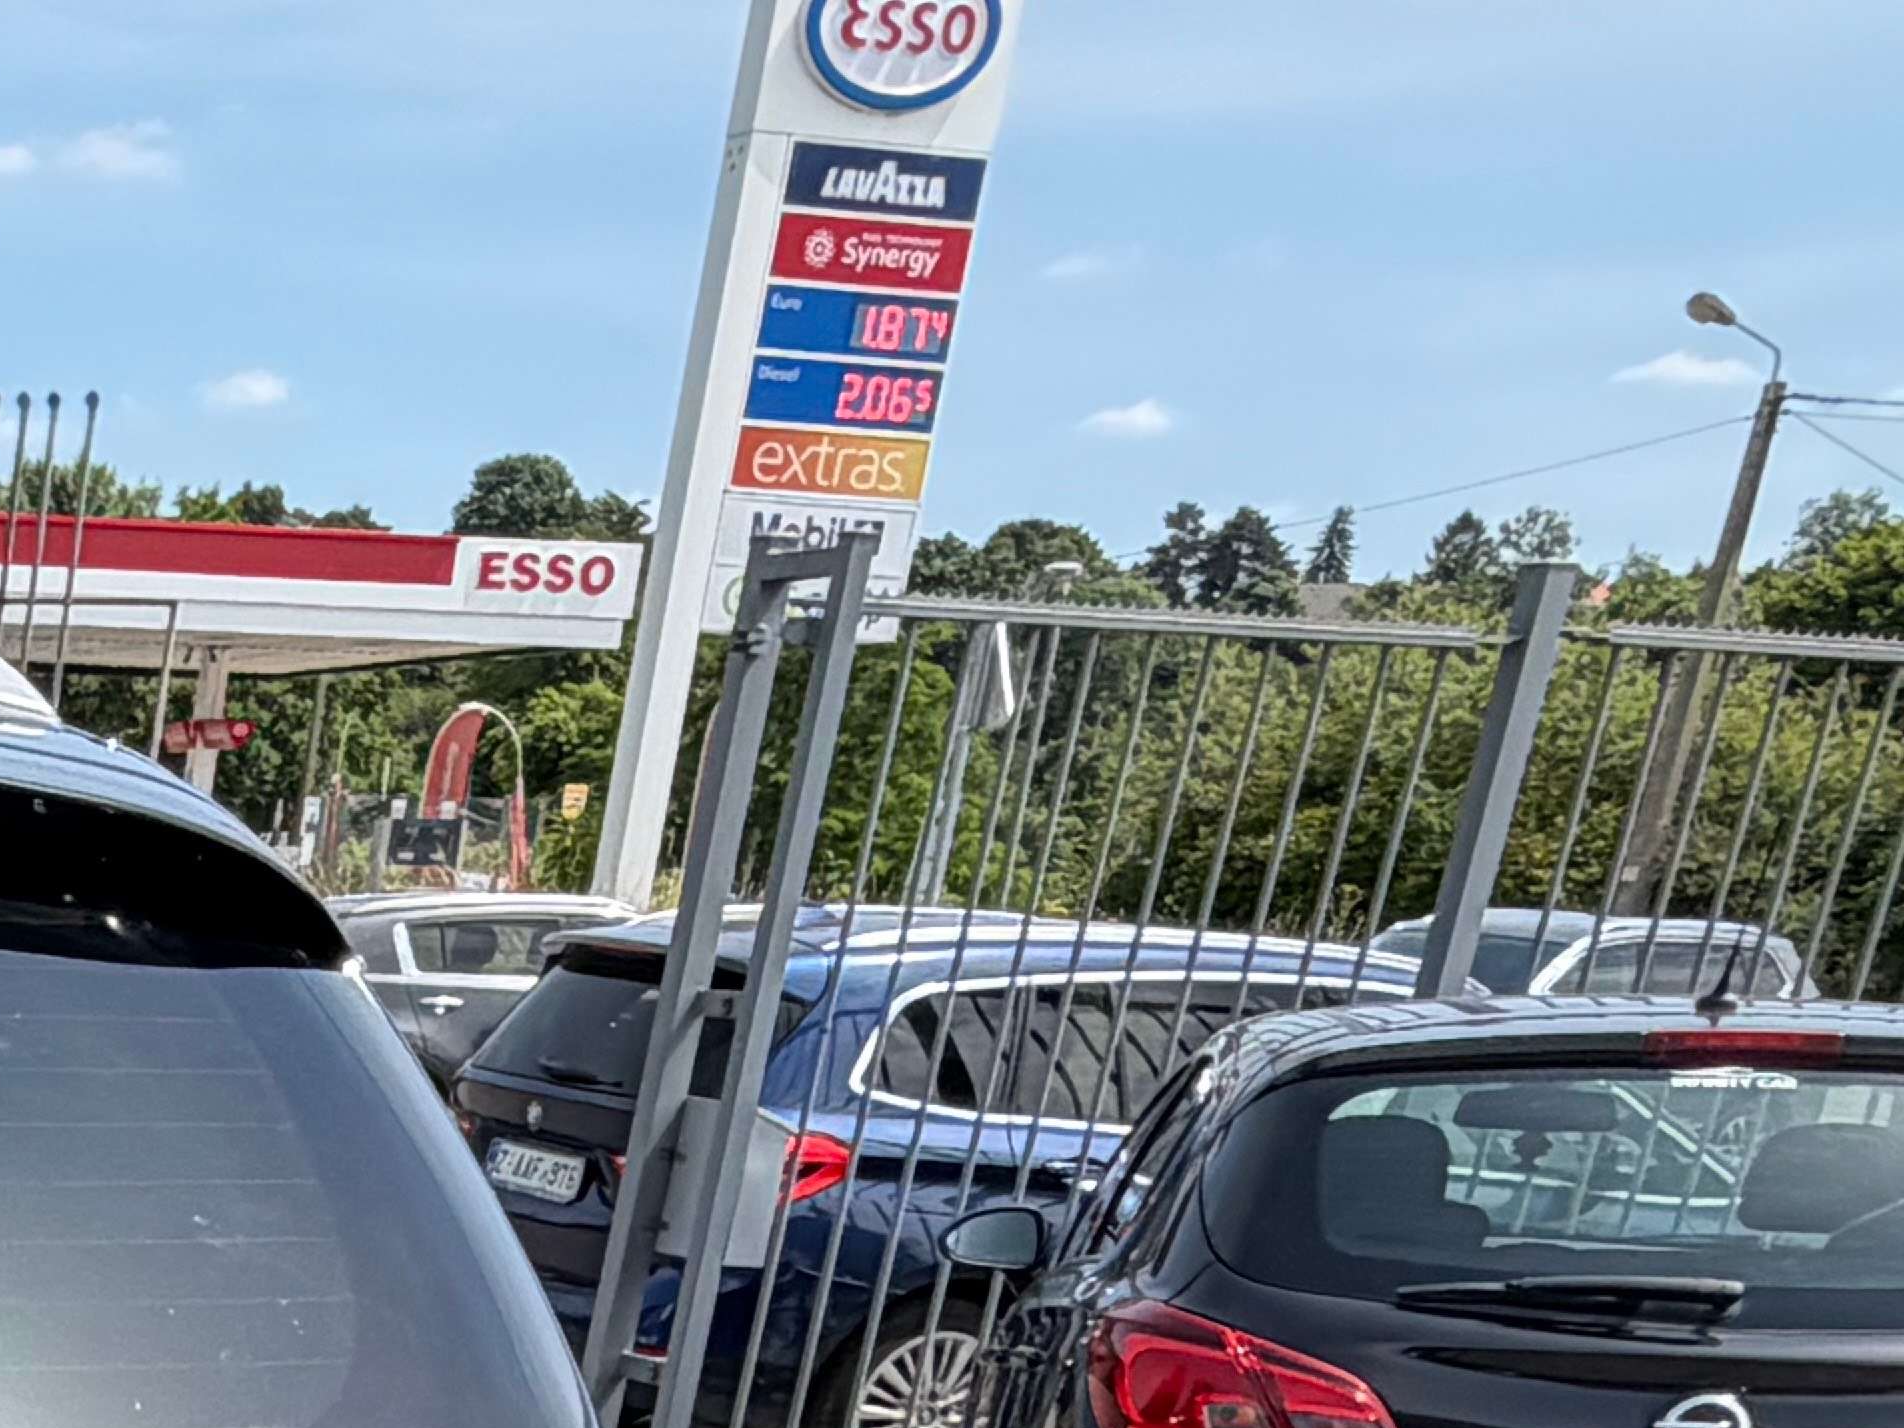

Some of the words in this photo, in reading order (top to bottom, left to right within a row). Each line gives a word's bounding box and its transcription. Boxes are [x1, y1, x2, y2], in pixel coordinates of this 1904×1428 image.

[820, 160, 945, 209] LAVAZZA
[840, 236, 940, 280] Synergy
[758, 364, 801, 383] Diesel
[752, 436, 905, 493] extras
[467, 552, 616, 597] ESSO
